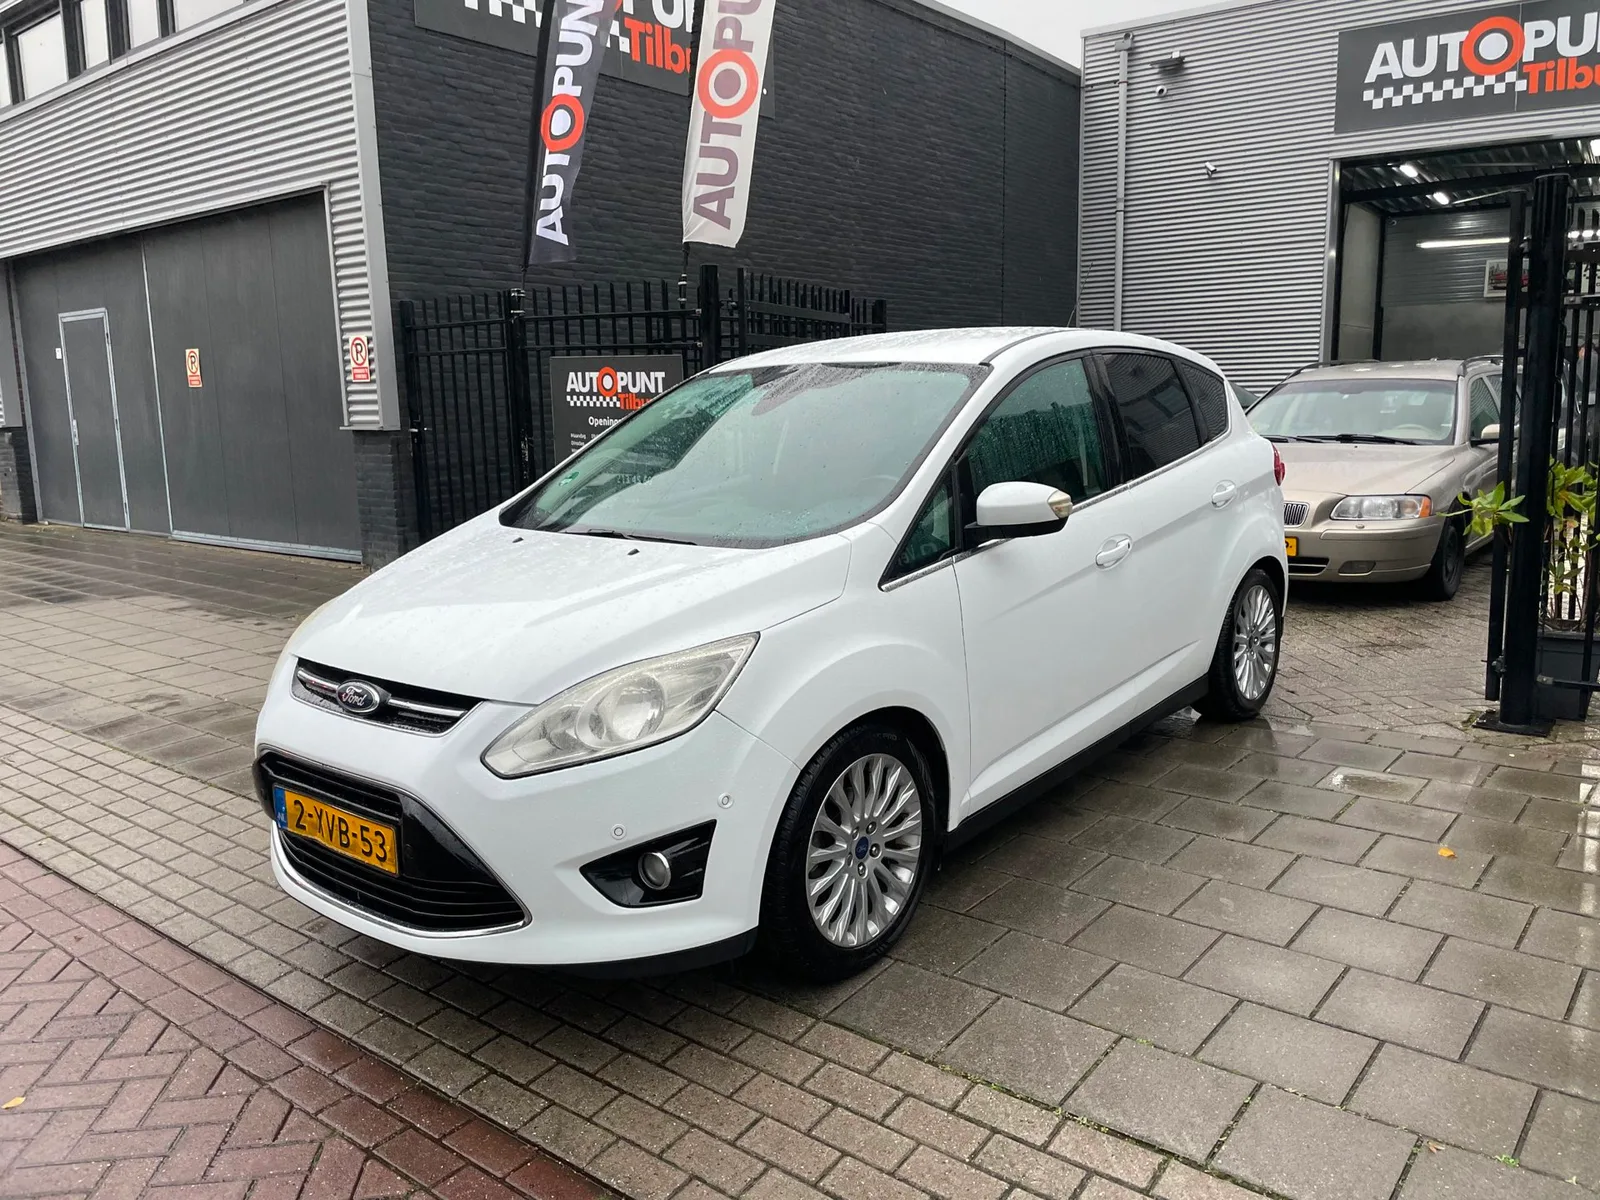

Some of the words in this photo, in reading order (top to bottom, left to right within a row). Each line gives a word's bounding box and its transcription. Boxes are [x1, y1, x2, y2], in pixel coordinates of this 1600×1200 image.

[1364, 12, 1600, 84] AUTOPU
[566, 366, 666, 397] AUTOPUNT
[341, 686, 366, 707] Ford
[293, 799, 388, 863] 2-XVB-53
